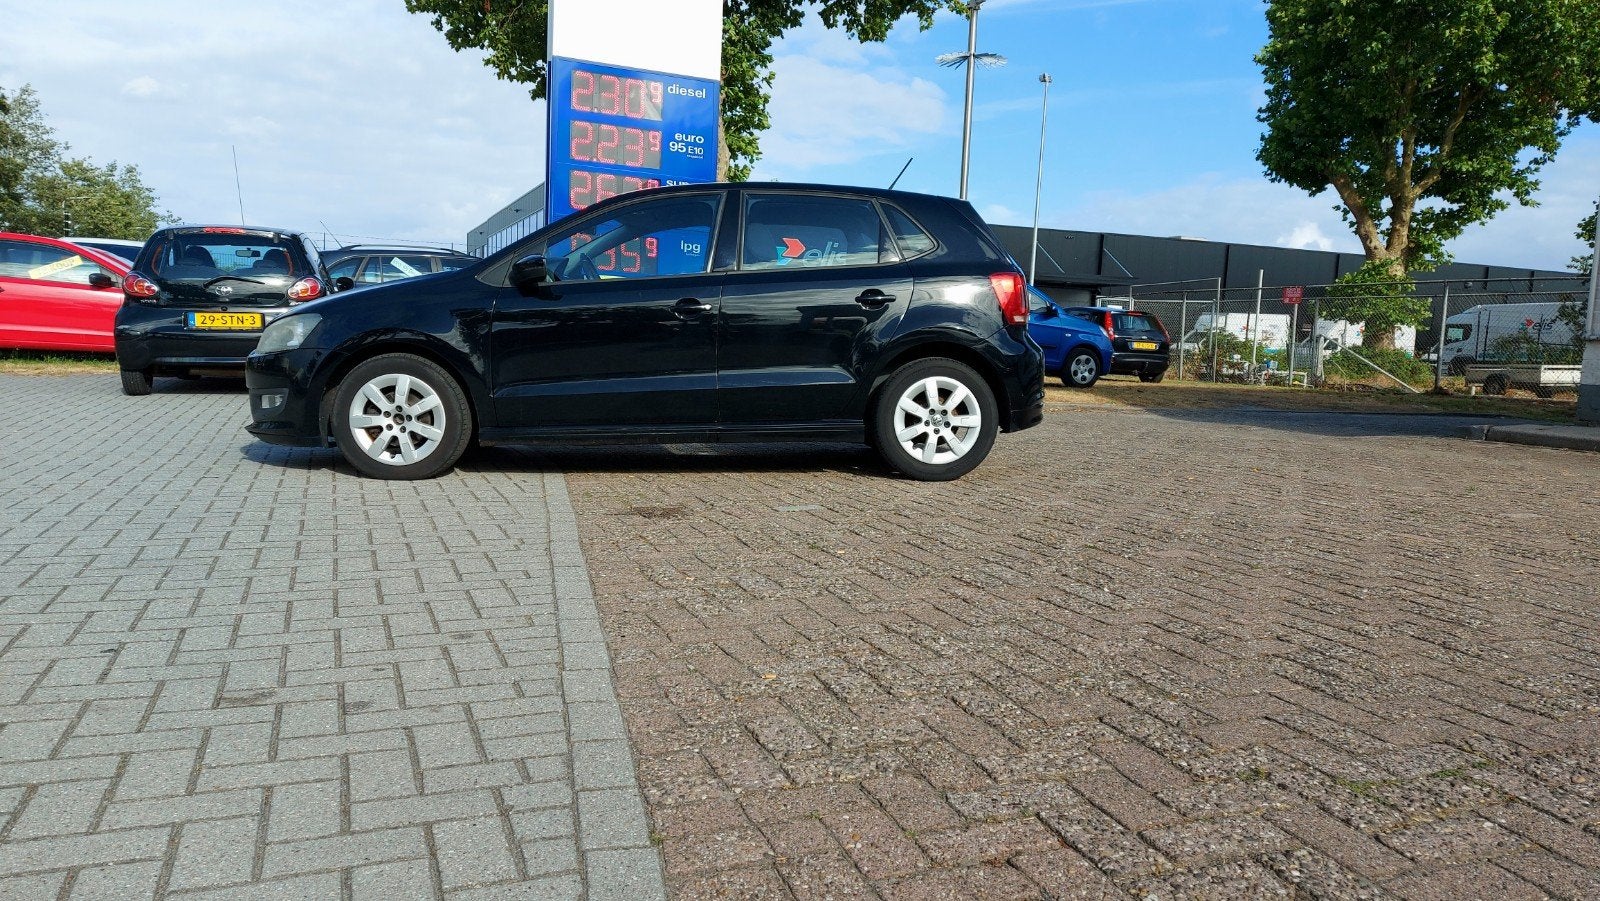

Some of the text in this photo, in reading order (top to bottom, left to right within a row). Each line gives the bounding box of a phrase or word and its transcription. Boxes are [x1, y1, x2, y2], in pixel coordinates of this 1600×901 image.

[667, 84, 706, 98] diesel
[674, 132, 705, 144] euro
[669, 141, 704, 155] 95 E10
[680, 240, 701, 253] lpg
[200, 315, 257, 325] 29-STN-3
